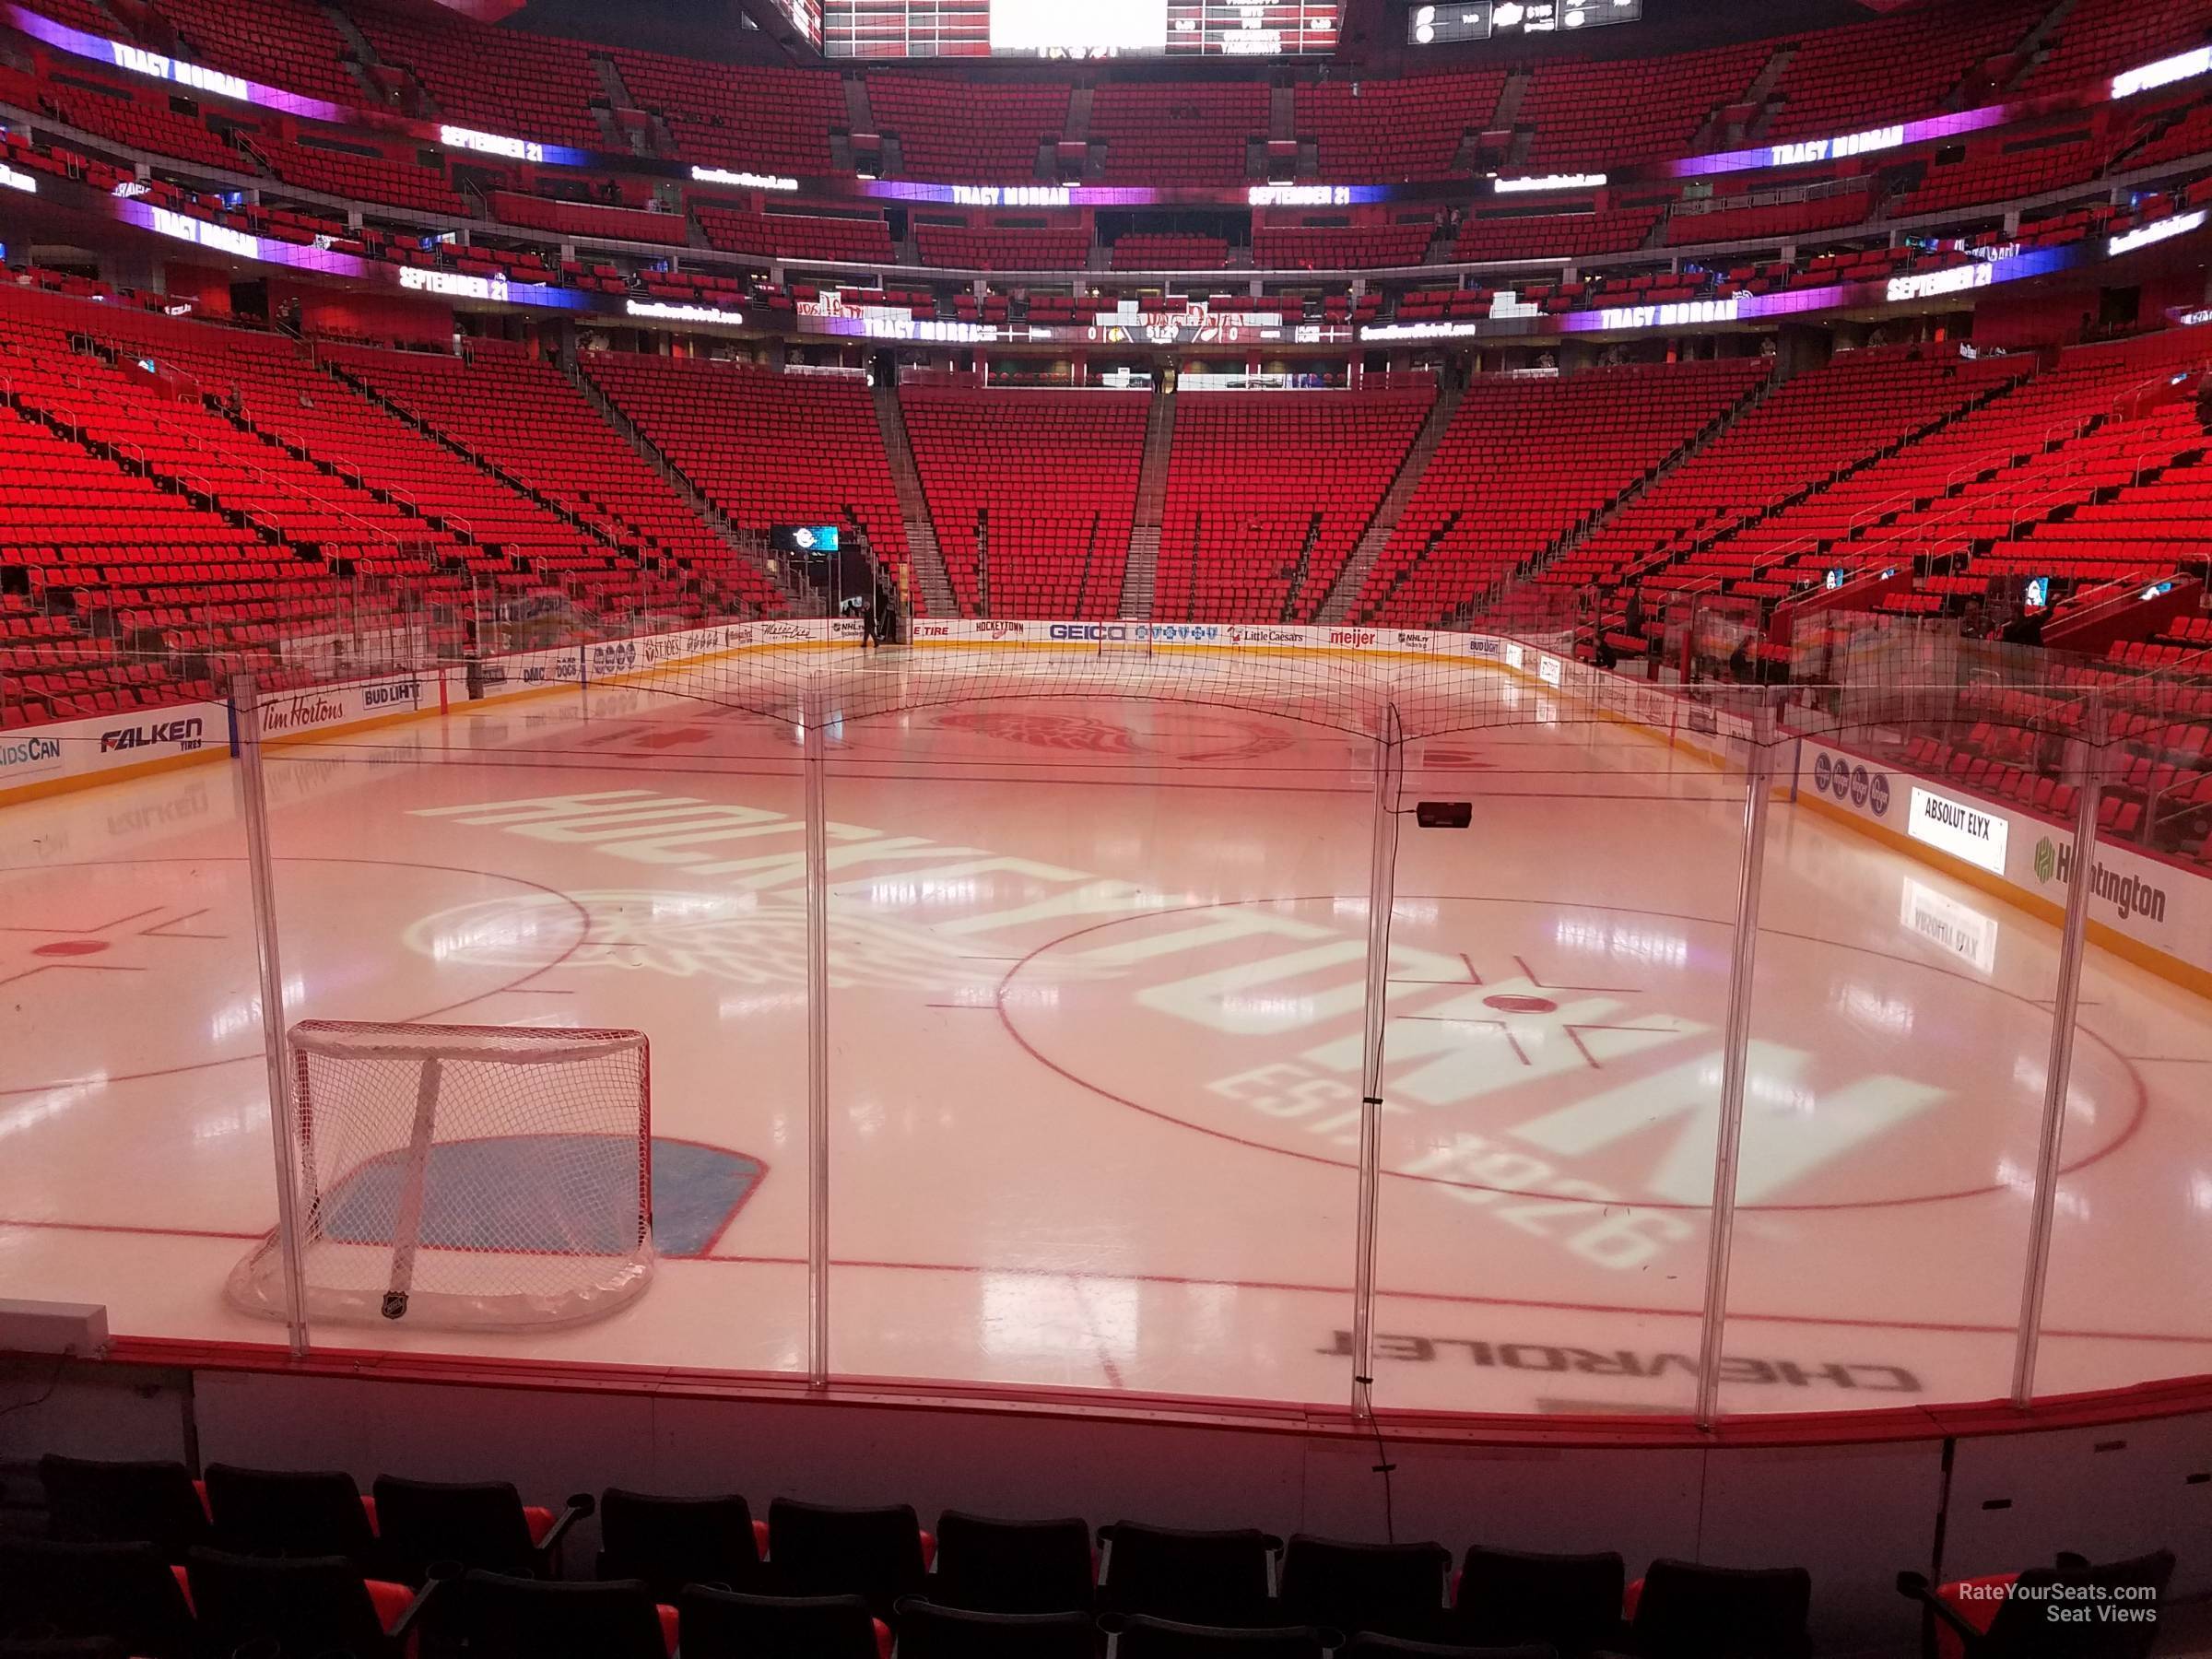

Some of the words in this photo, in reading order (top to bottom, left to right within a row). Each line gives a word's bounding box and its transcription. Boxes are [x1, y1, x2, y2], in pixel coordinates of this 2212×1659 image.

[441, 125, 524, 159] SEPTEMBER
[1772, 139, 1829, 166] TRACY
[1833, 125, 1904, 158] MORGAN
[952, 185, 999, 206] TRACY
[1003, 187, 1070, 206] MORGAN
[1248, 186, 1332, 206] SEPTEMBER
[1334, 186, 1350, 206] 21
[399, 265, 488, 299] SEPTEMBER
[490, 280, 508, 301] 21
[1887, 265, 1974, 301] SEPTEMBER
[1975, 262, 1993, 286] 21
[1601, 305, 1656, 329] TRACY
[1660, 300, 1739, 324] MORGAN
[865, 319, 915, 338] TRACY
[924, 627, 948, 635] TIRE
[976, 621, 1023, 633] HOCKEYTOWN
[1050, 624, 1125, 640] GEICO
[1244, 631, 1268, 641] Little
[1269, 631, 1303, 642] Caesars
[1330, 629, 1375, 647] meijer
[1470, 640, 1483, 651] BUD
[1485, 641, 1499, 653] LIGHT
[524, 666, 545, 682] DMC
[365, 688, 388, 705] BUD
[263, 699, 288, 732] Tim
[290, 696, 343, 727] Hortons
[100, 717, 203, 753] FALKEN
[181, 738, 202, 752] TIRES
[1924, 797, 1965, 830] ABSOLUT
[1967, 812, 1991, 841] ELYX
[1407, 1132, 1696, 1269] 1926
[1316, 1330, 1924, 1393] CHEVROLET
